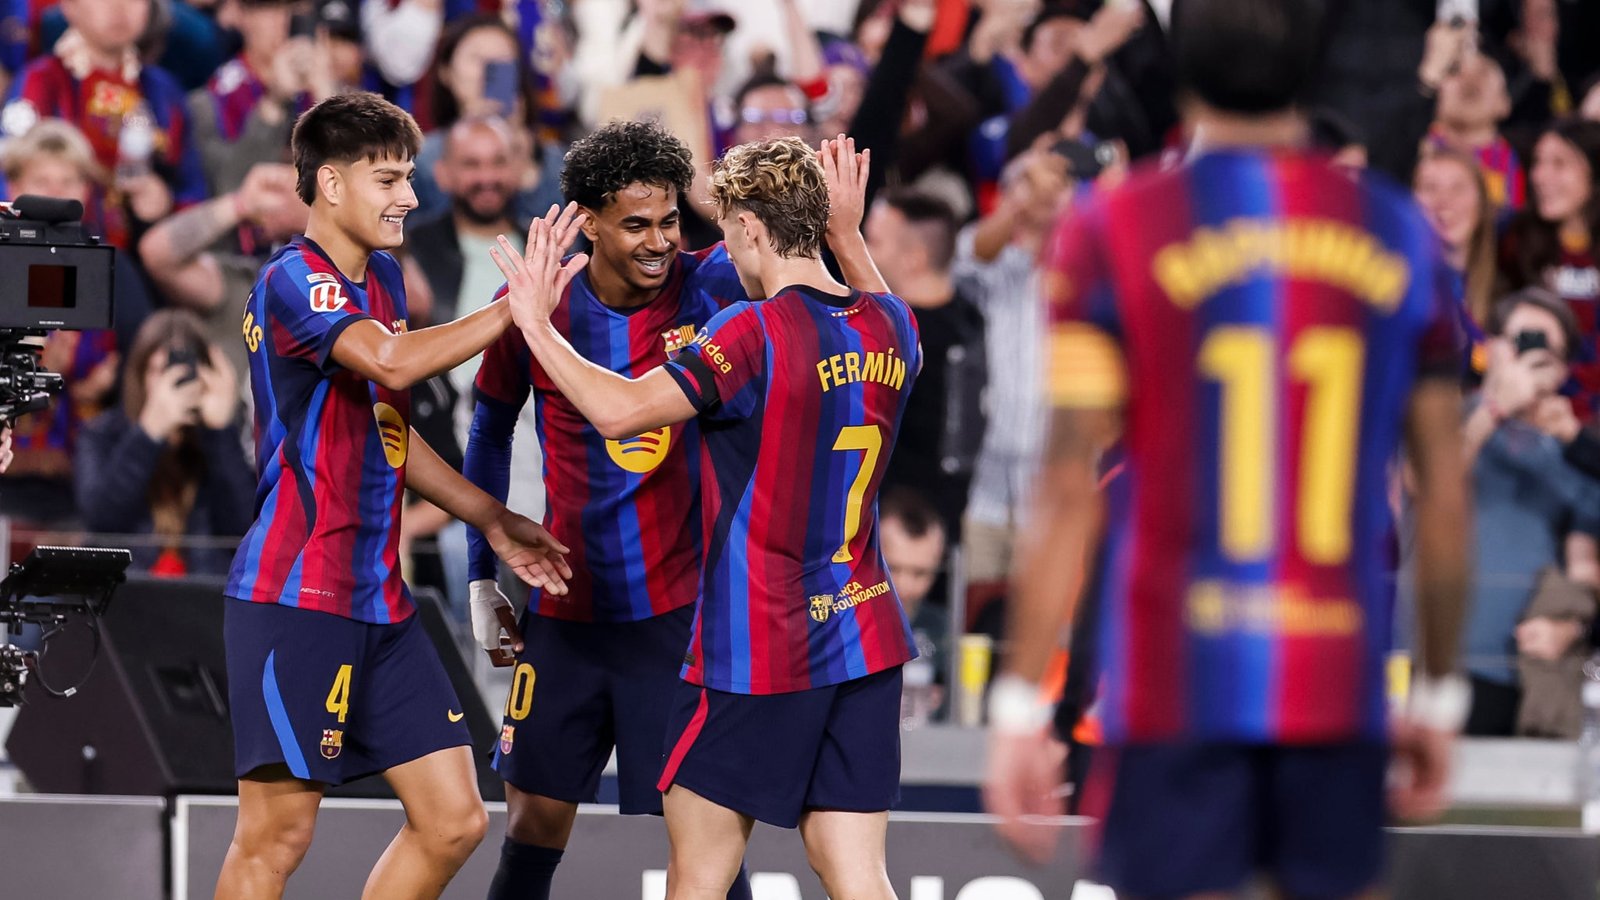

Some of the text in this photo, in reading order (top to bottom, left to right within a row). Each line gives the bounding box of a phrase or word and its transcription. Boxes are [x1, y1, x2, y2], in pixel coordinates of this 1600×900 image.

[816, 348, 906, 392] FERMÍN
[1198, 325, 1366, 565] 11
[832, 425, 882, 563] 7
[832, 581, 891, 614] FOUNDATION
[836, 581, 863, 601] ARÇA
[325, 664, 353, 723] 4
[504, 661, 536, 721] 0
